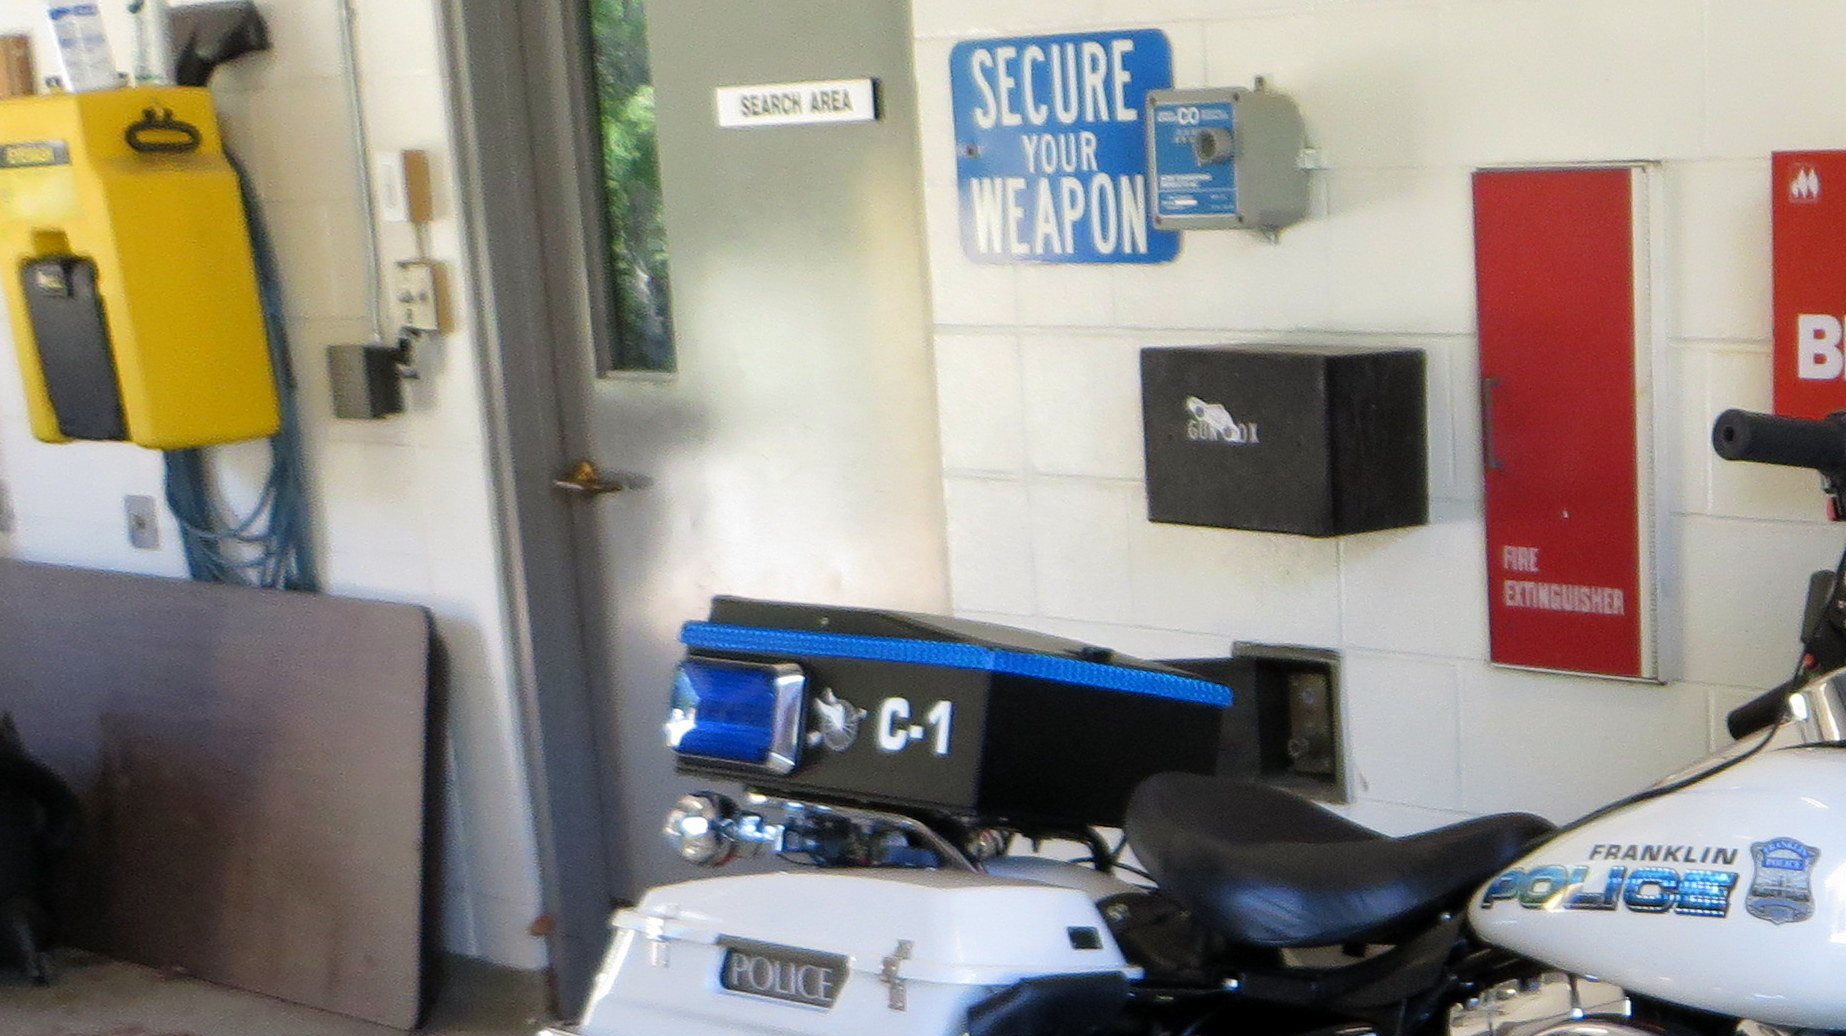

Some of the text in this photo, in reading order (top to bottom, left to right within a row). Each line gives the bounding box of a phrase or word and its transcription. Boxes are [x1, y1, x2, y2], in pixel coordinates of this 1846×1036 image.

[741, 89, 853, 117] SEARCH AREA
[971, 39, 1138, 128] SECURE
[1177, 107, 1199, 125] CO
[1021, 131, 1098, 173] YOUR
[970, 172, 1148, 254] WEAPON
[1503, 545, 1539, 572] FIRE
[1504, 580, 1625, 615] EXTINGUISHER
[879, 697, 952, 754] C-1
[1589, 844, 1738, 865] FRANKLIN
[1480, 865, 1739, 918] POLICE
[731, 952, 834, 1001] POLICE
